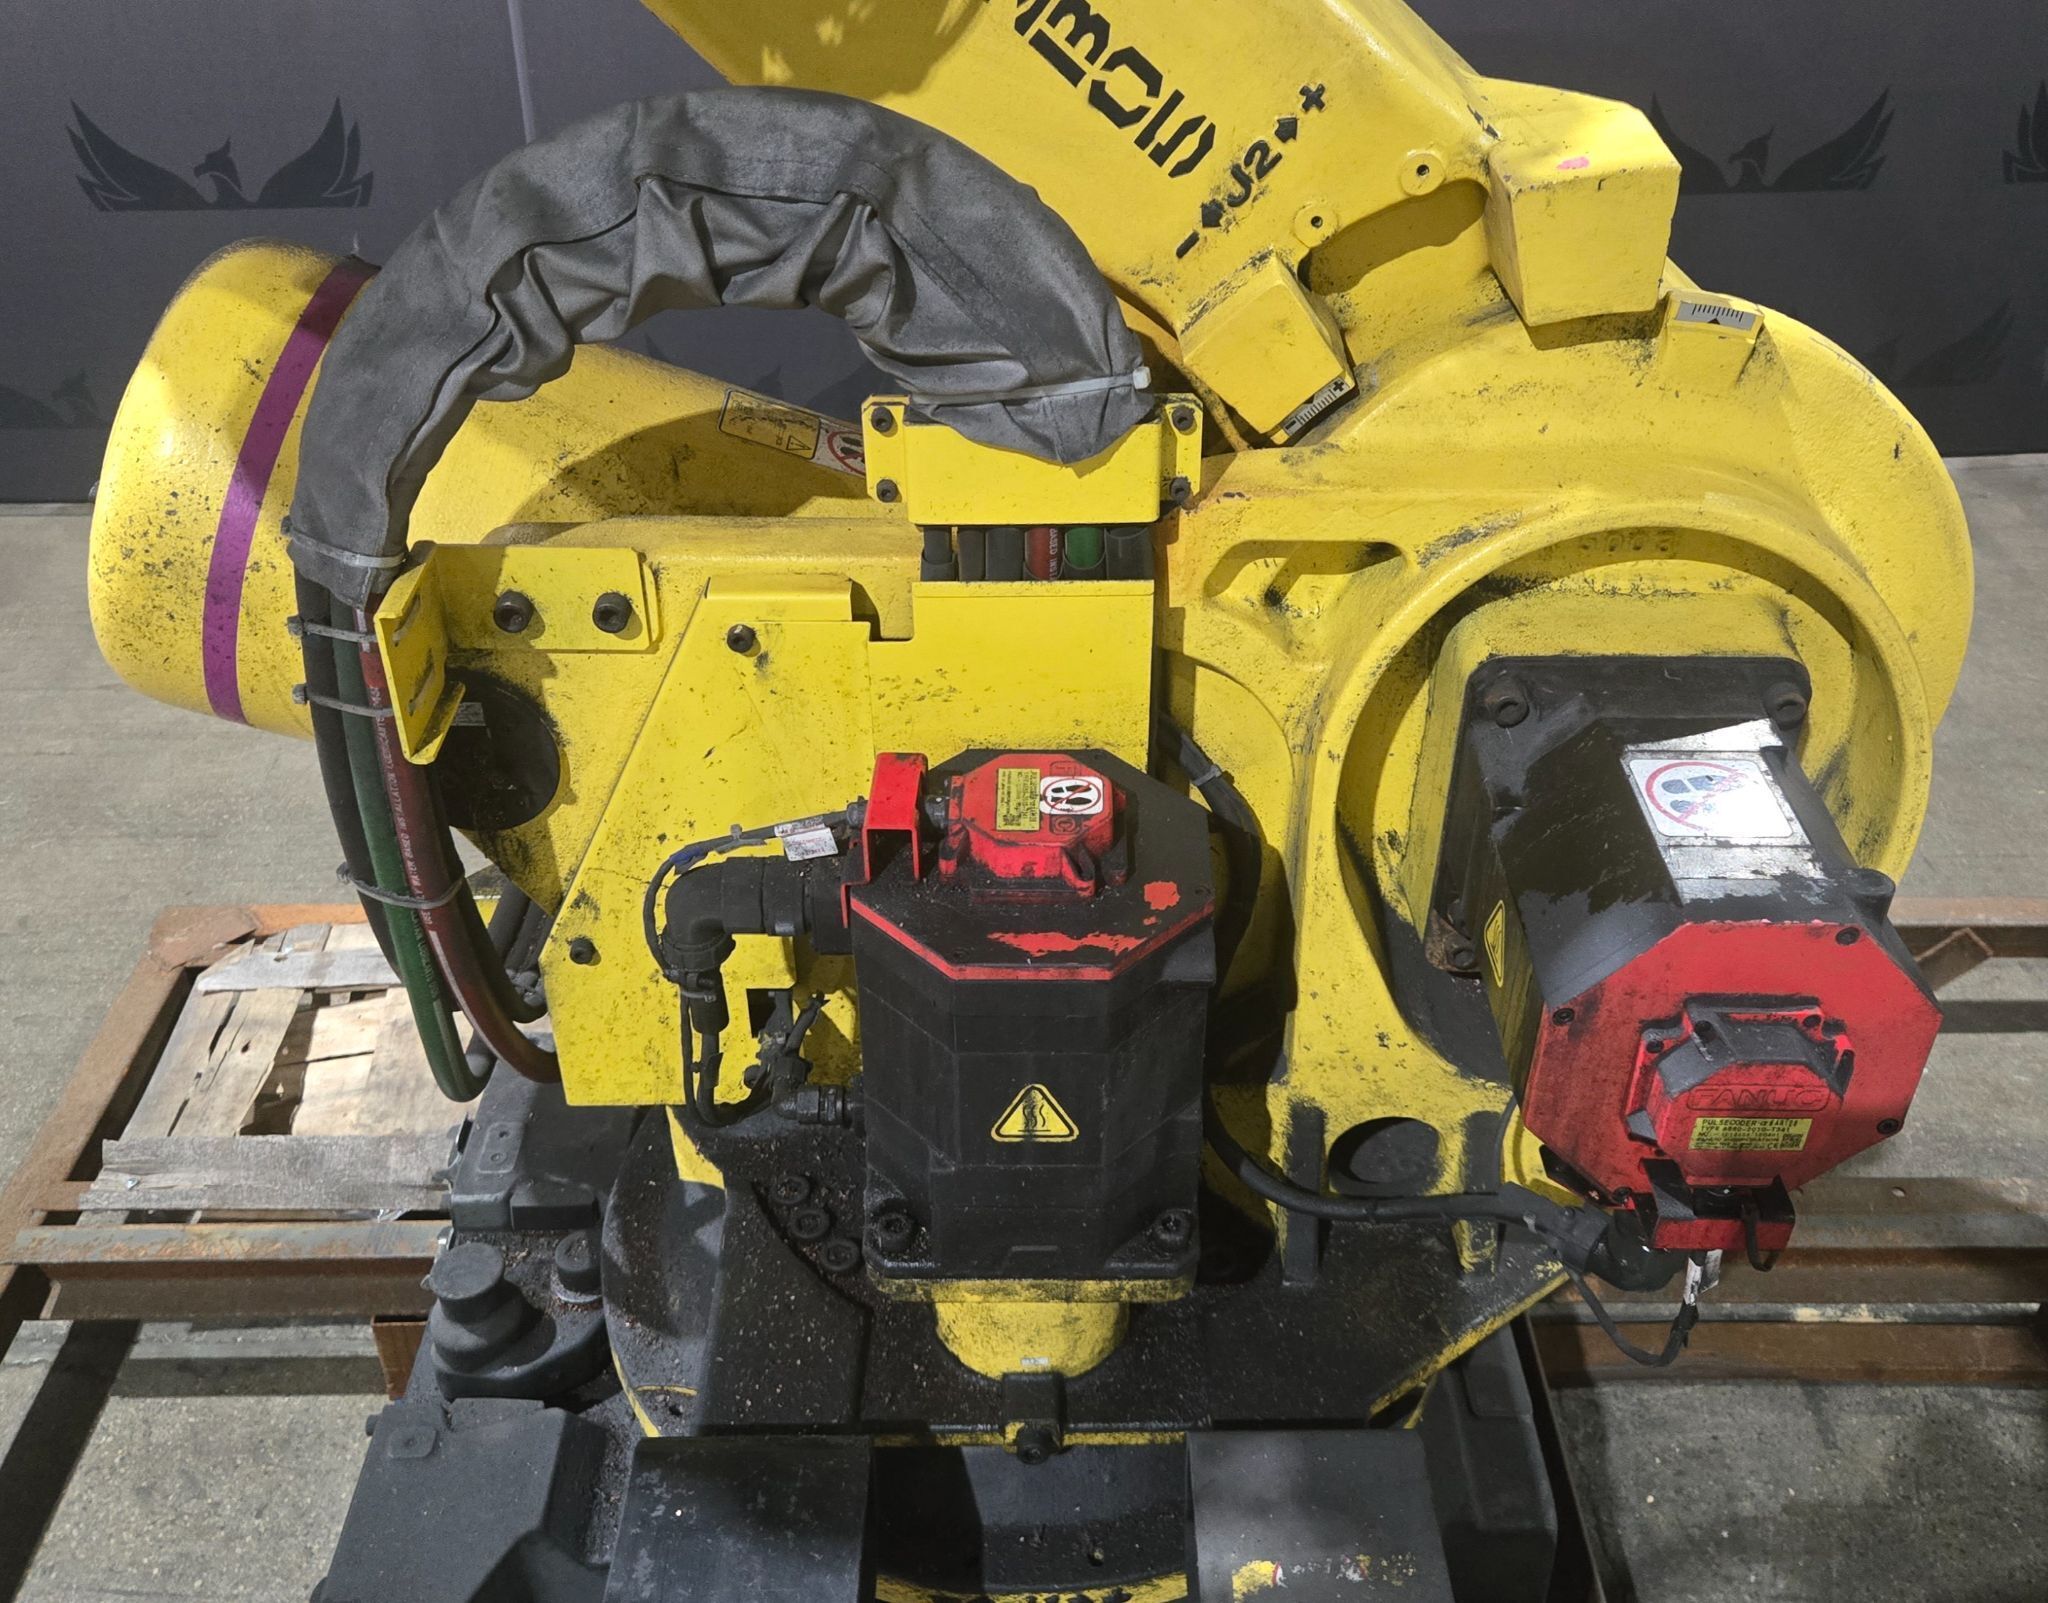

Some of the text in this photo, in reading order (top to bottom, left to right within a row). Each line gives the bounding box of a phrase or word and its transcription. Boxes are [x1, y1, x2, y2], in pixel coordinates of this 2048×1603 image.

[1227, 139, 1283, 208] J2
[1694, 1088, 1823, 1107] FANUC
[1702, 1119, 1757, 1127] PULSECODER
